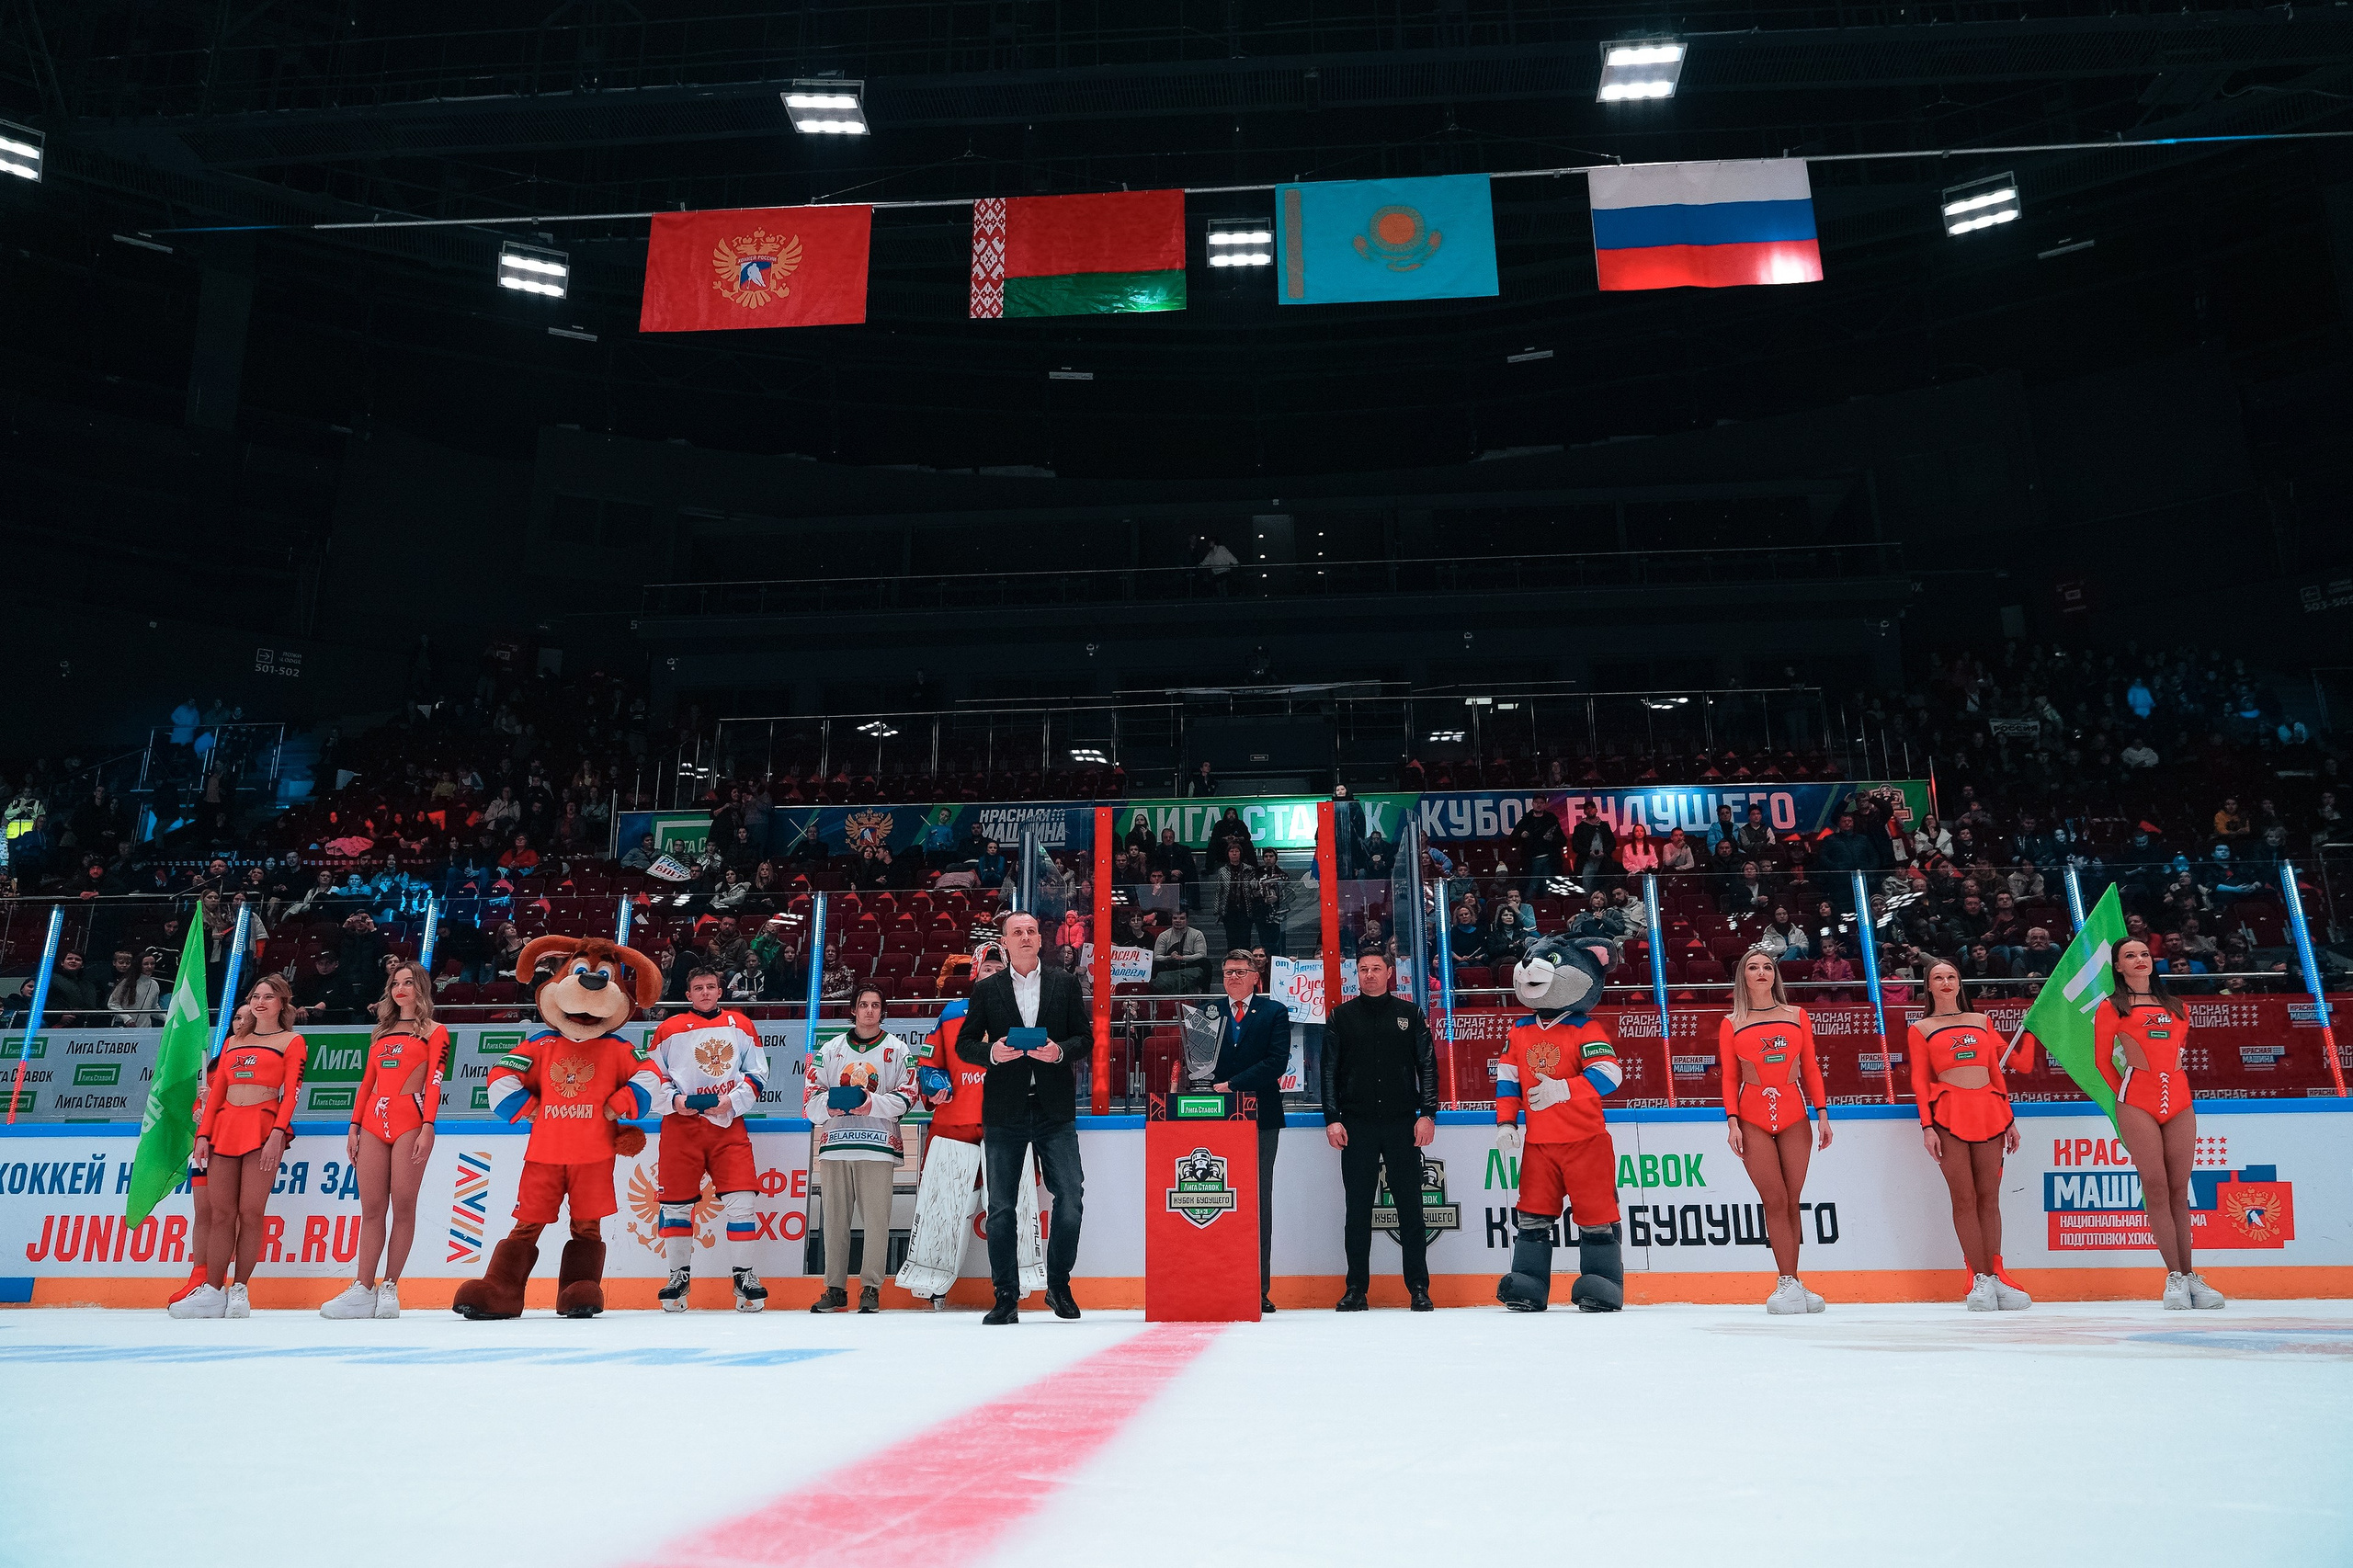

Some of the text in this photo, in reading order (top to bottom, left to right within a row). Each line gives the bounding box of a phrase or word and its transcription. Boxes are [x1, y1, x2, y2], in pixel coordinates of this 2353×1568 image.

[255, 663, 300, 677] 501-502
[1245, 801, 1388, 842] СТАК
[665, 837, 696, 854] ЛГА
[2188, 1005, 2229, 1016] РАСНАЯ
[728, 1016, 736, 1027] A
[1436, 1017, 1485, 1028] КАСНАЯ
[2188, 1016, 2231, 1028] АШИНА
[1618, 1025, 1668, 1038] МАШИН
[1812, 1024, 1852, 1035] АШИНА
[883, 1048, 894, 1062] C
[11, 1068, 54, 1083] САВОК
[807, 1068, 818, 1084] 4
[907, 1069, 915, 1085] 7
[1627, 1098, 1677, 1108] КРАСНА
[1825, 1096, 1863, 1106] АСНАЯ
[2007, 1093, 2051, 1103] РАСНАЯ
[544, 1104, 594, 1119] РОССИЯ
[828, 1131, 887, 1142] BELARUSKALI
[1617, 1153, 1707, 1188] АВОК
[1199, 1183, 1220, 1191] СТАВОК
[2053, 1175, 2198, 1209] МАШИ
[1174, 1196, 1230, 1205] КУБОК БУДУЩЕГО
[1375, 1212, 1398, 1223] КУБО
[2060, 1214, 2143, 1229] НАЦИОНАЛЬНАЯ
[1628, 1202, 1839, 1249] БУДУЩГО
[26, 1215, 361, 1264] JUNIOR.R.RU
[2060, 1232, 2127, 1247] ПОДГОТОВКИ
